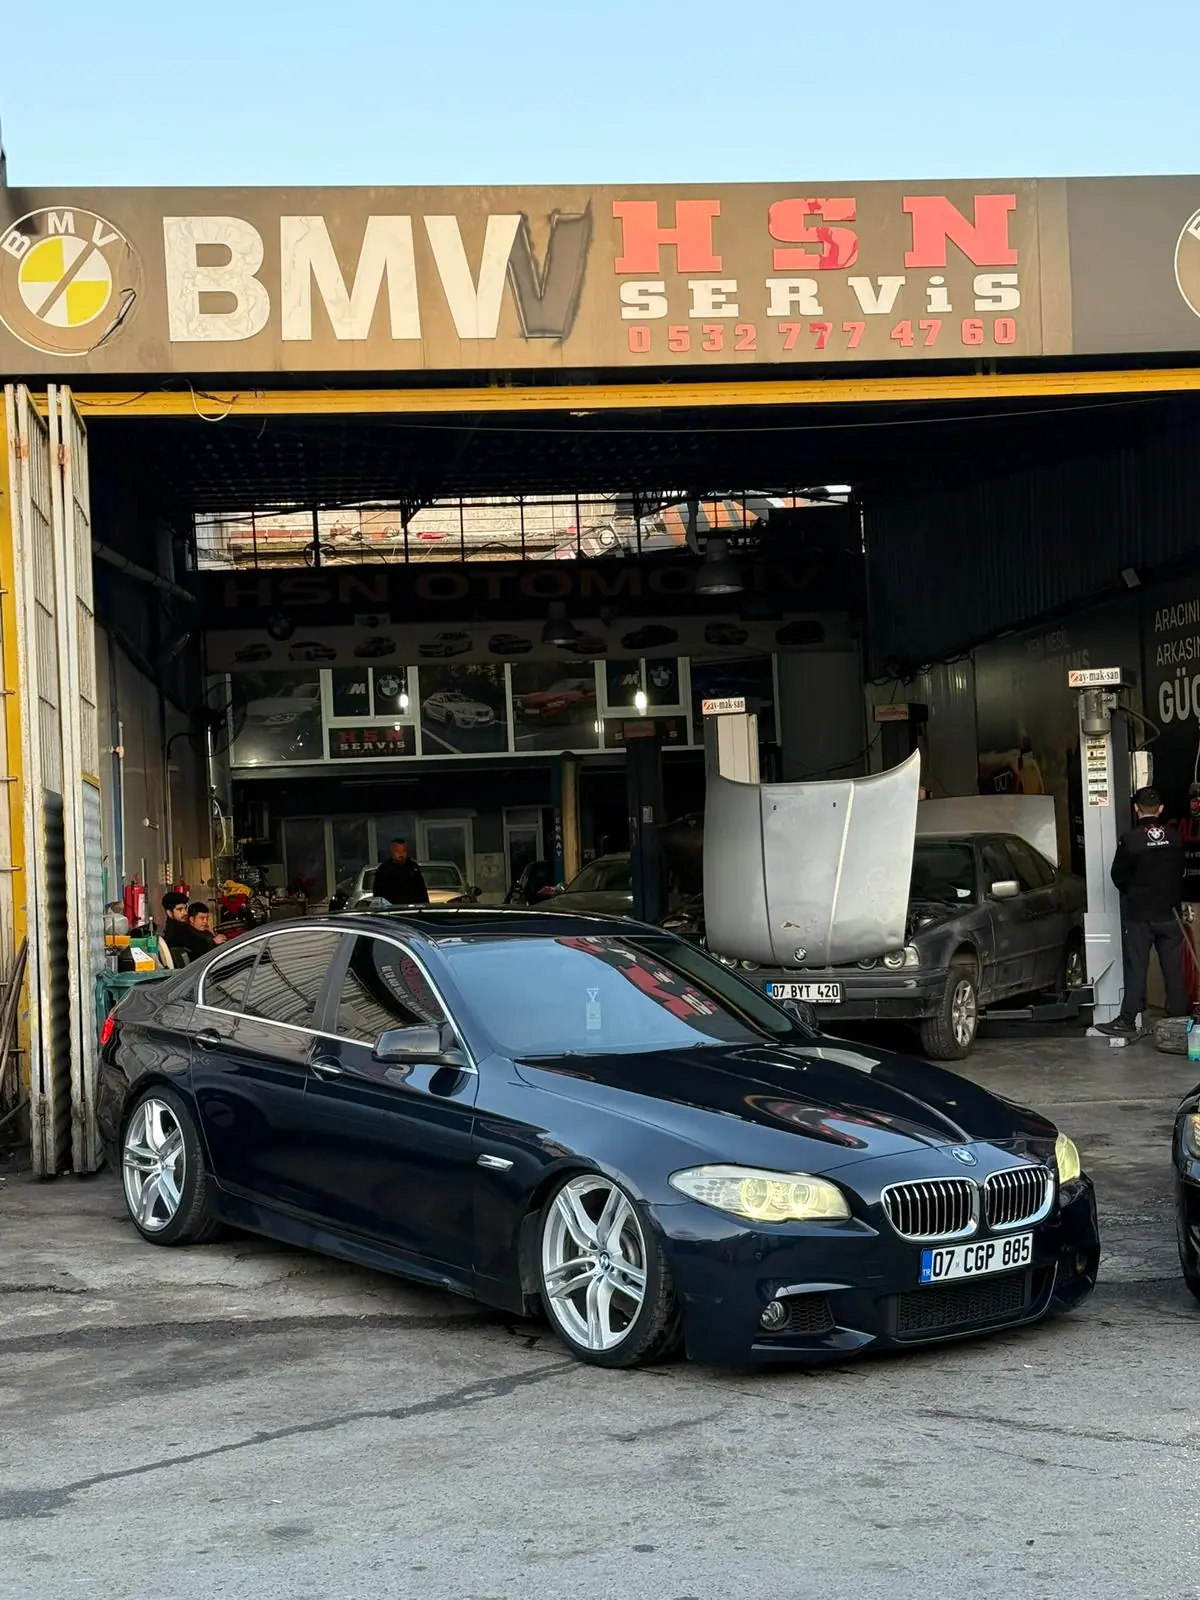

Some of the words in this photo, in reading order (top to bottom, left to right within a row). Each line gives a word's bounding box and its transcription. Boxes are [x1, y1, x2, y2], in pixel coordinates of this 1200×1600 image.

[778, 322, 866, 350] 777
[891, 319, 942, 347] 47
[962, 318, 1016, 344] 60
[222, 573, 392, 608] HSN
[414, 558, 826, 602] OTOMOİV
[773, 985, 785, 998] 07
[791, 985, 811, 998] BYT
[817, 985, 839, 998] 420
[933, 1250, 954, 1277] 07
[964, 1243, 995, 1273] CGP
[1002, 1237, 1030, 1266] 885
